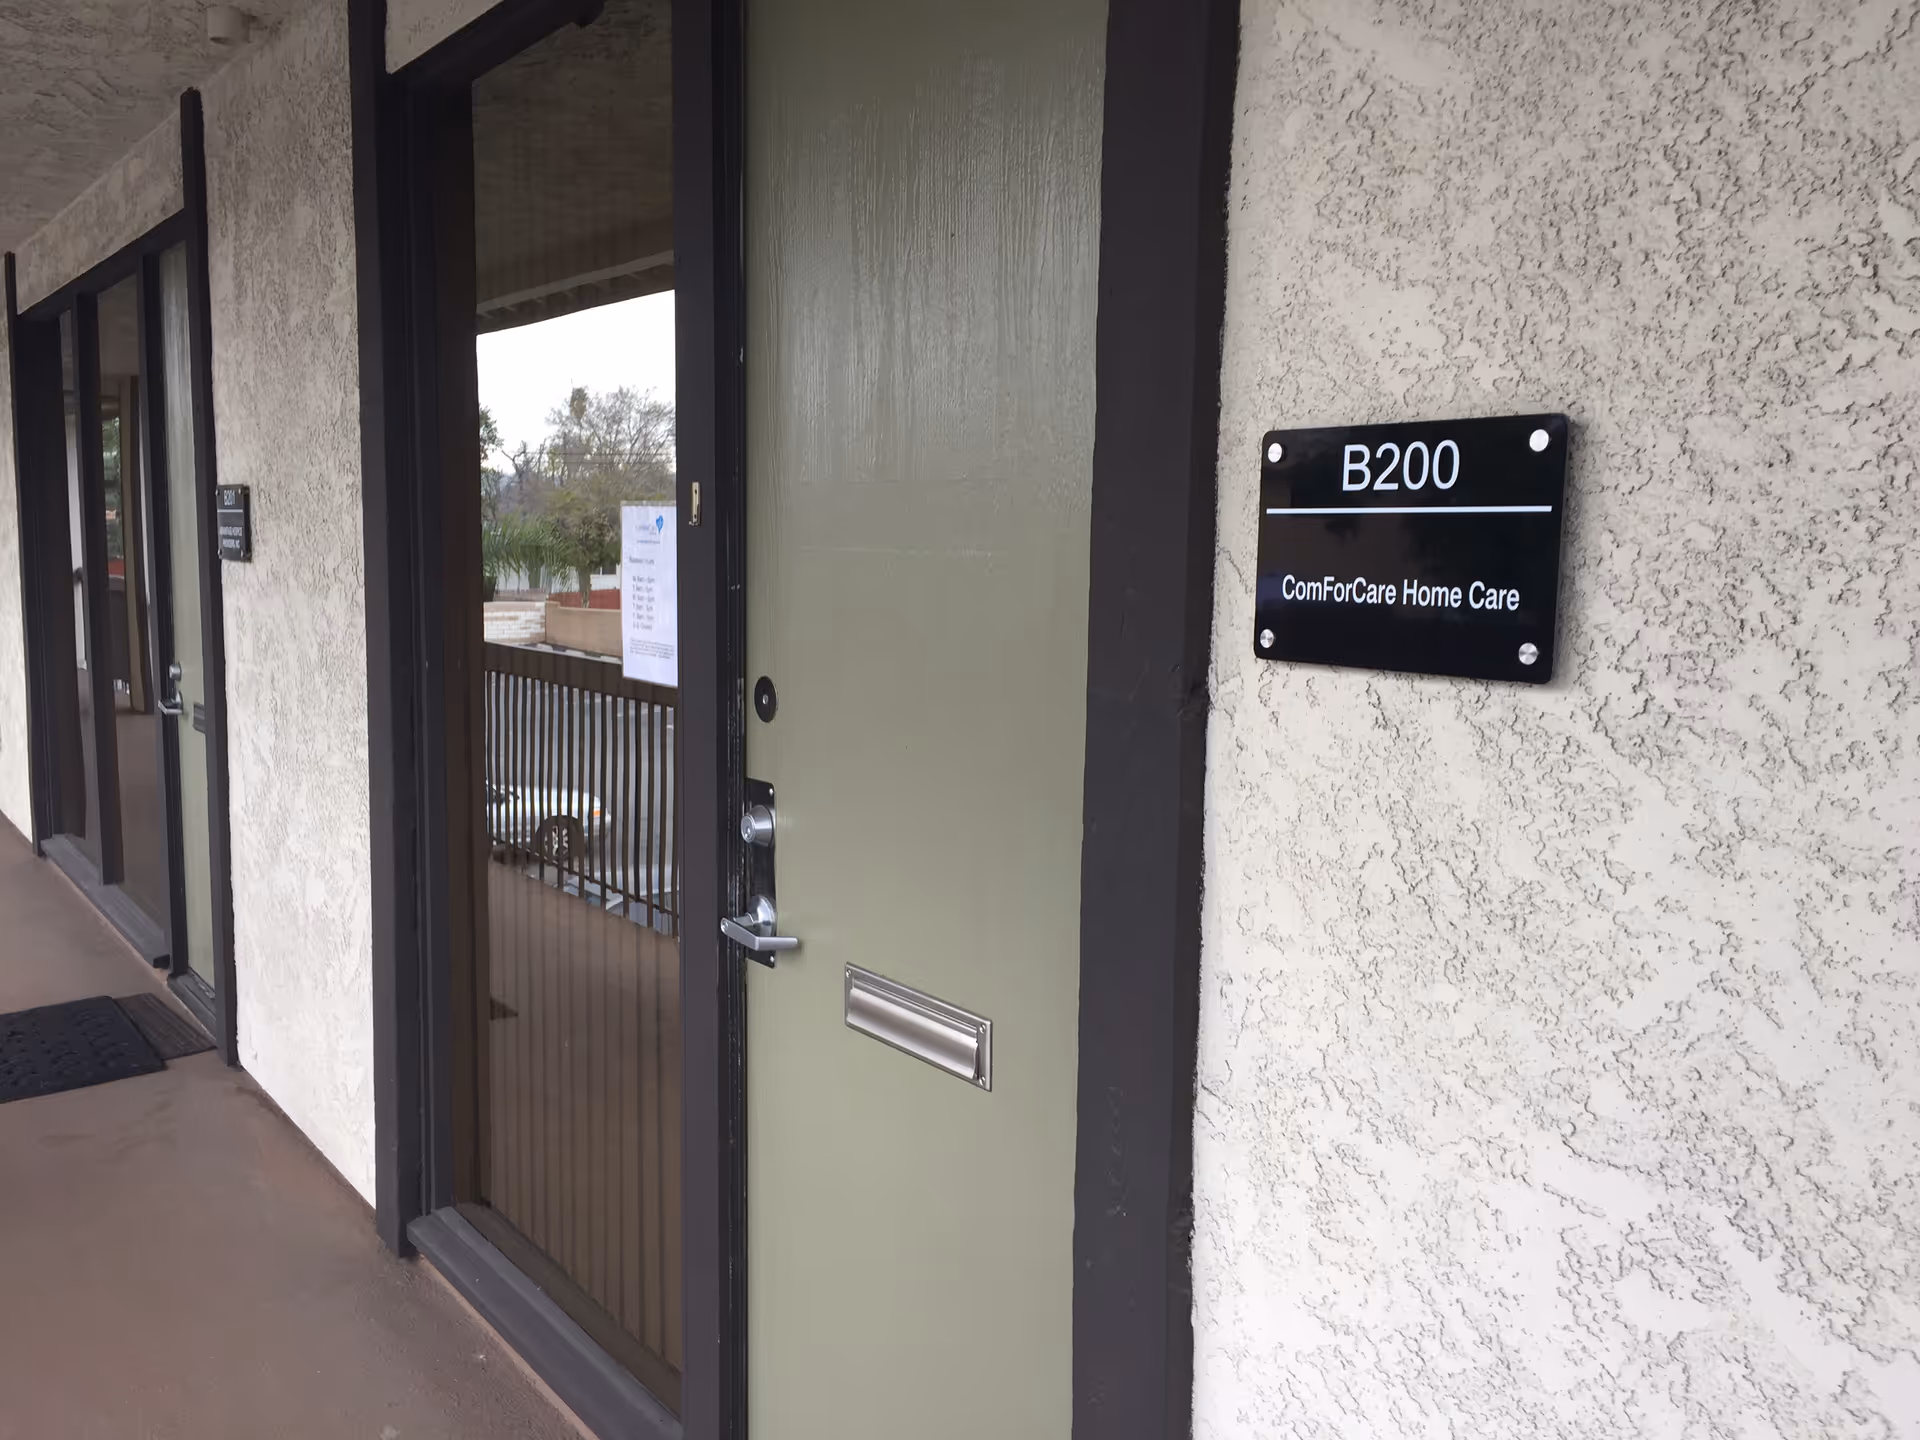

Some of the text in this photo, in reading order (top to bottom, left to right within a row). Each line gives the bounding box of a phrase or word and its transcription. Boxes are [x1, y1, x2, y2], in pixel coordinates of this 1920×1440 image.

[1342, 439, 1460, 492] B200
[1281, 574, 1521, 611] ComForCare Home Care
